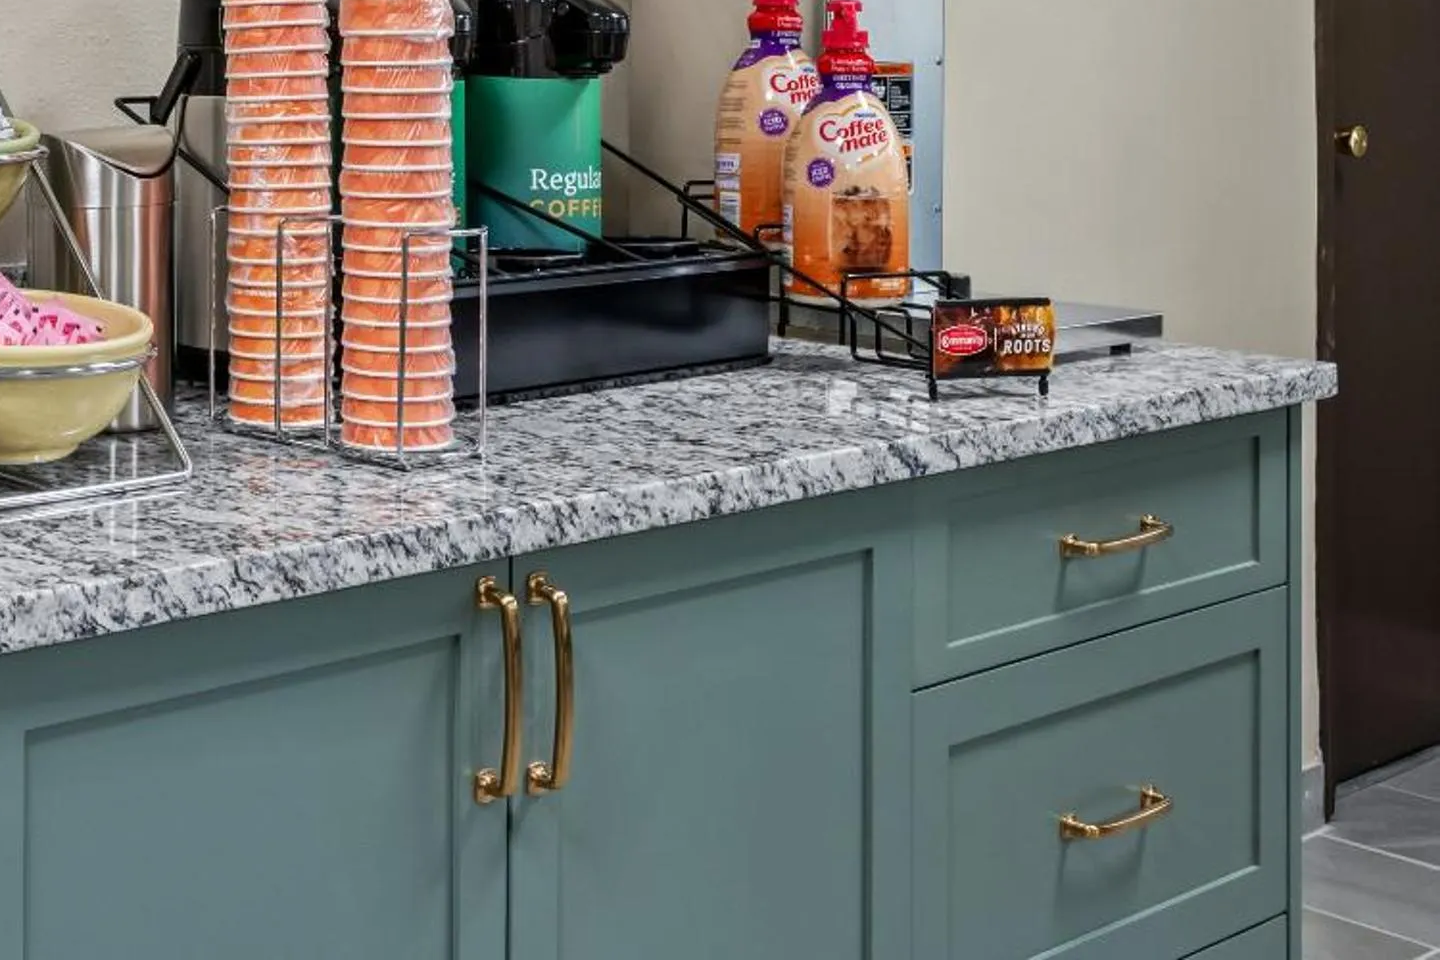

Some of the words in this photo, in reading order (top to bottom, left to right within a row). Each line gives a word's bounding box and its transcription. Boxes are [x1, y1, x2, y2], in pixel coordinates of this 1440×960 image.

[770, 73, 821, 93] Coffe
[819, 119, 885, 142] Coffee
[839, 130, 889, 153] mate
[529, 165, 602, 197] Regula
[1003, 338, 1051, 354] ROOTS
